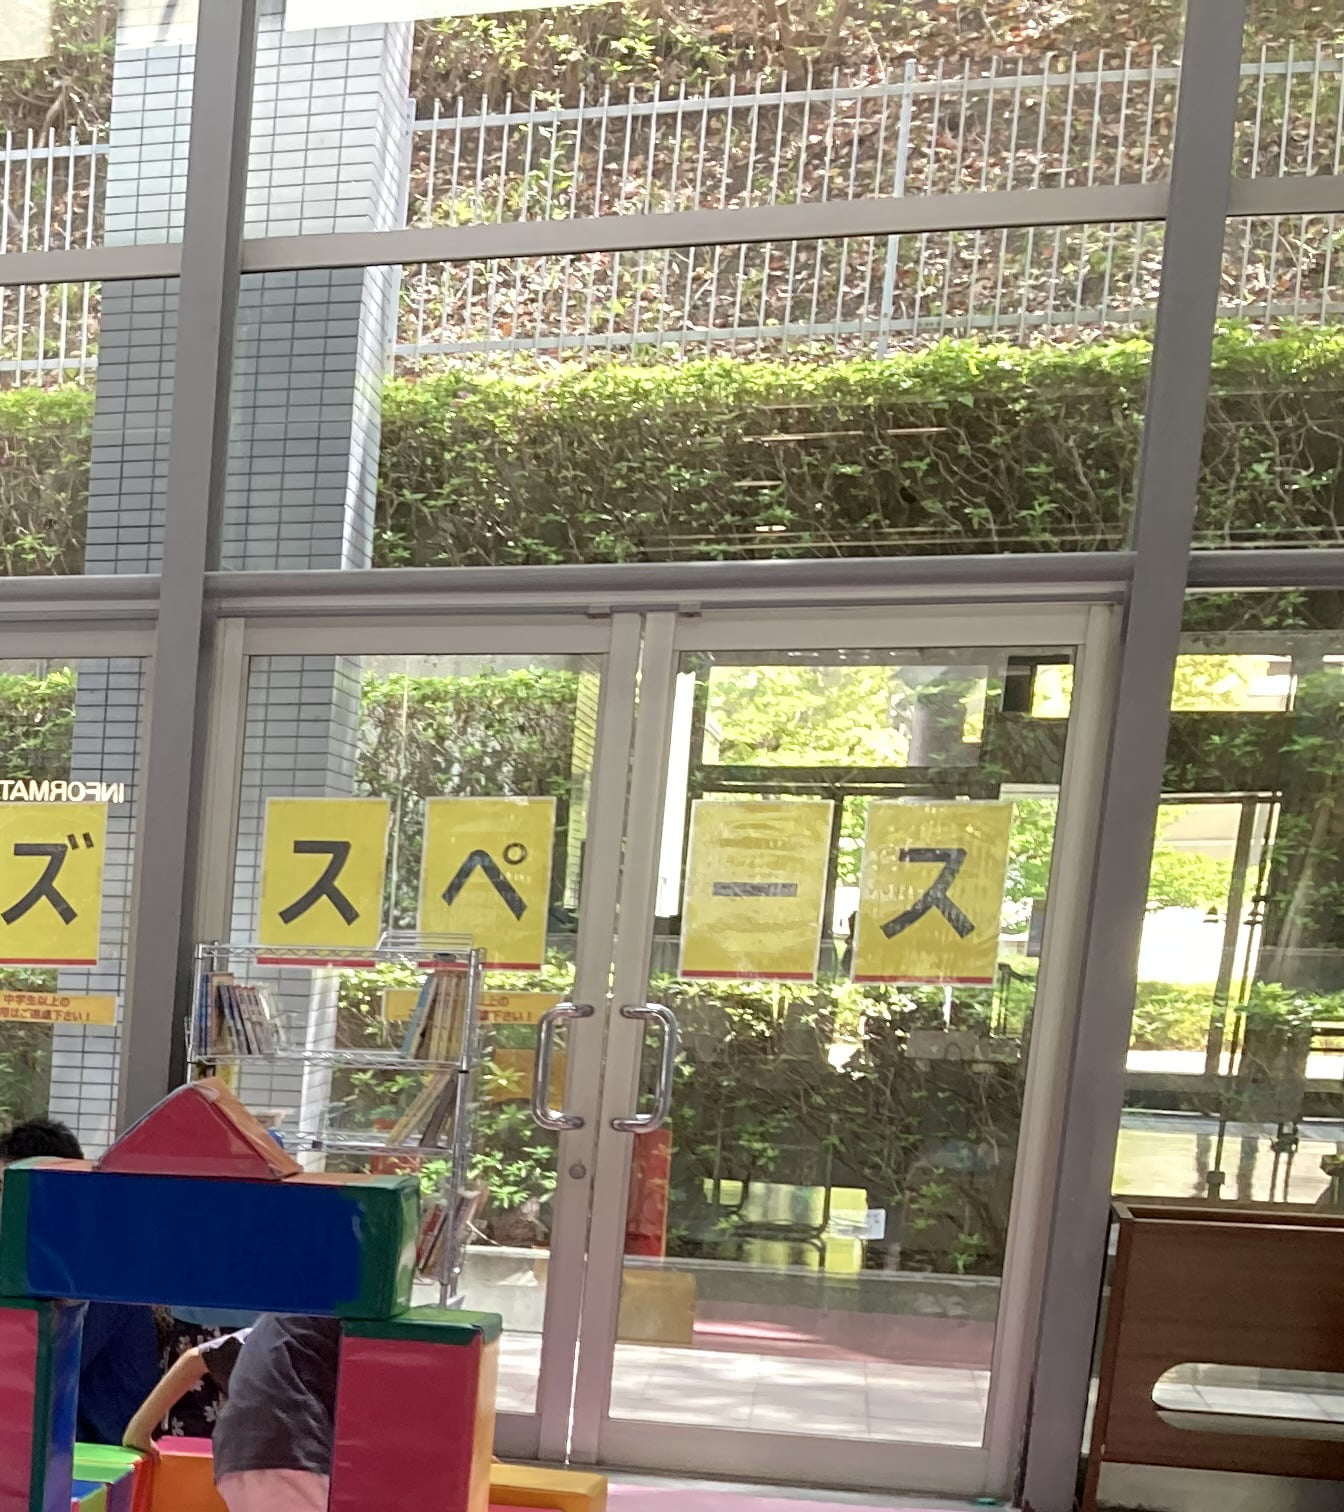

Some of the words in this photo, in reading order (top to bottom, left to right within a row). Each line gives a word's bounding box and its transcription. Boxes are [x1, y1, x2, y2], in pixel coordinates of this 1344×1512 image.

[3, 993, 71, 1007] 中学生以上の
